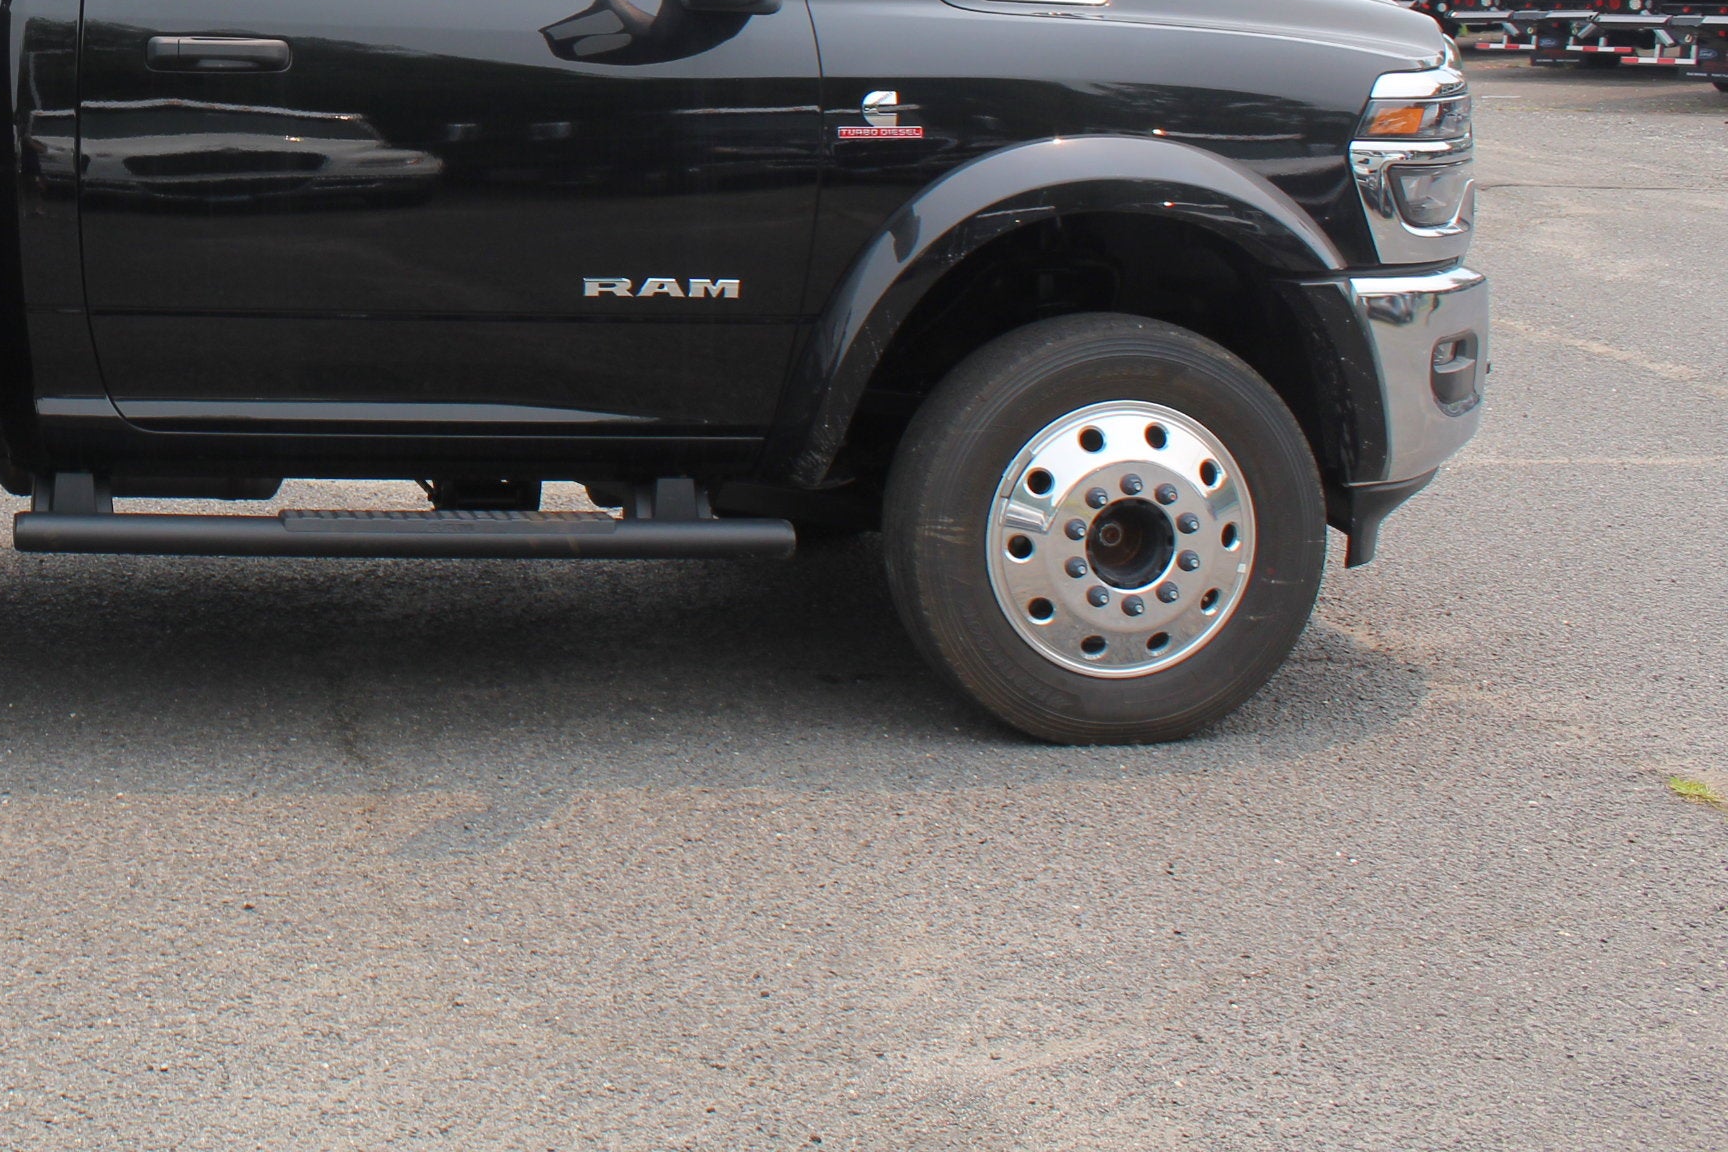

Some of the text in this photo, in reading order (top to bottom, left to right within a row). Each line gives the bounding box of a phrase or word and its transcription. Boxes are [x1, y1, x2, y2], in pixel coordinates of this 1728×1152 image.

[840, 128, 921, 136] TURBO DIESEL
[582, 277, 741, 298] RAM
